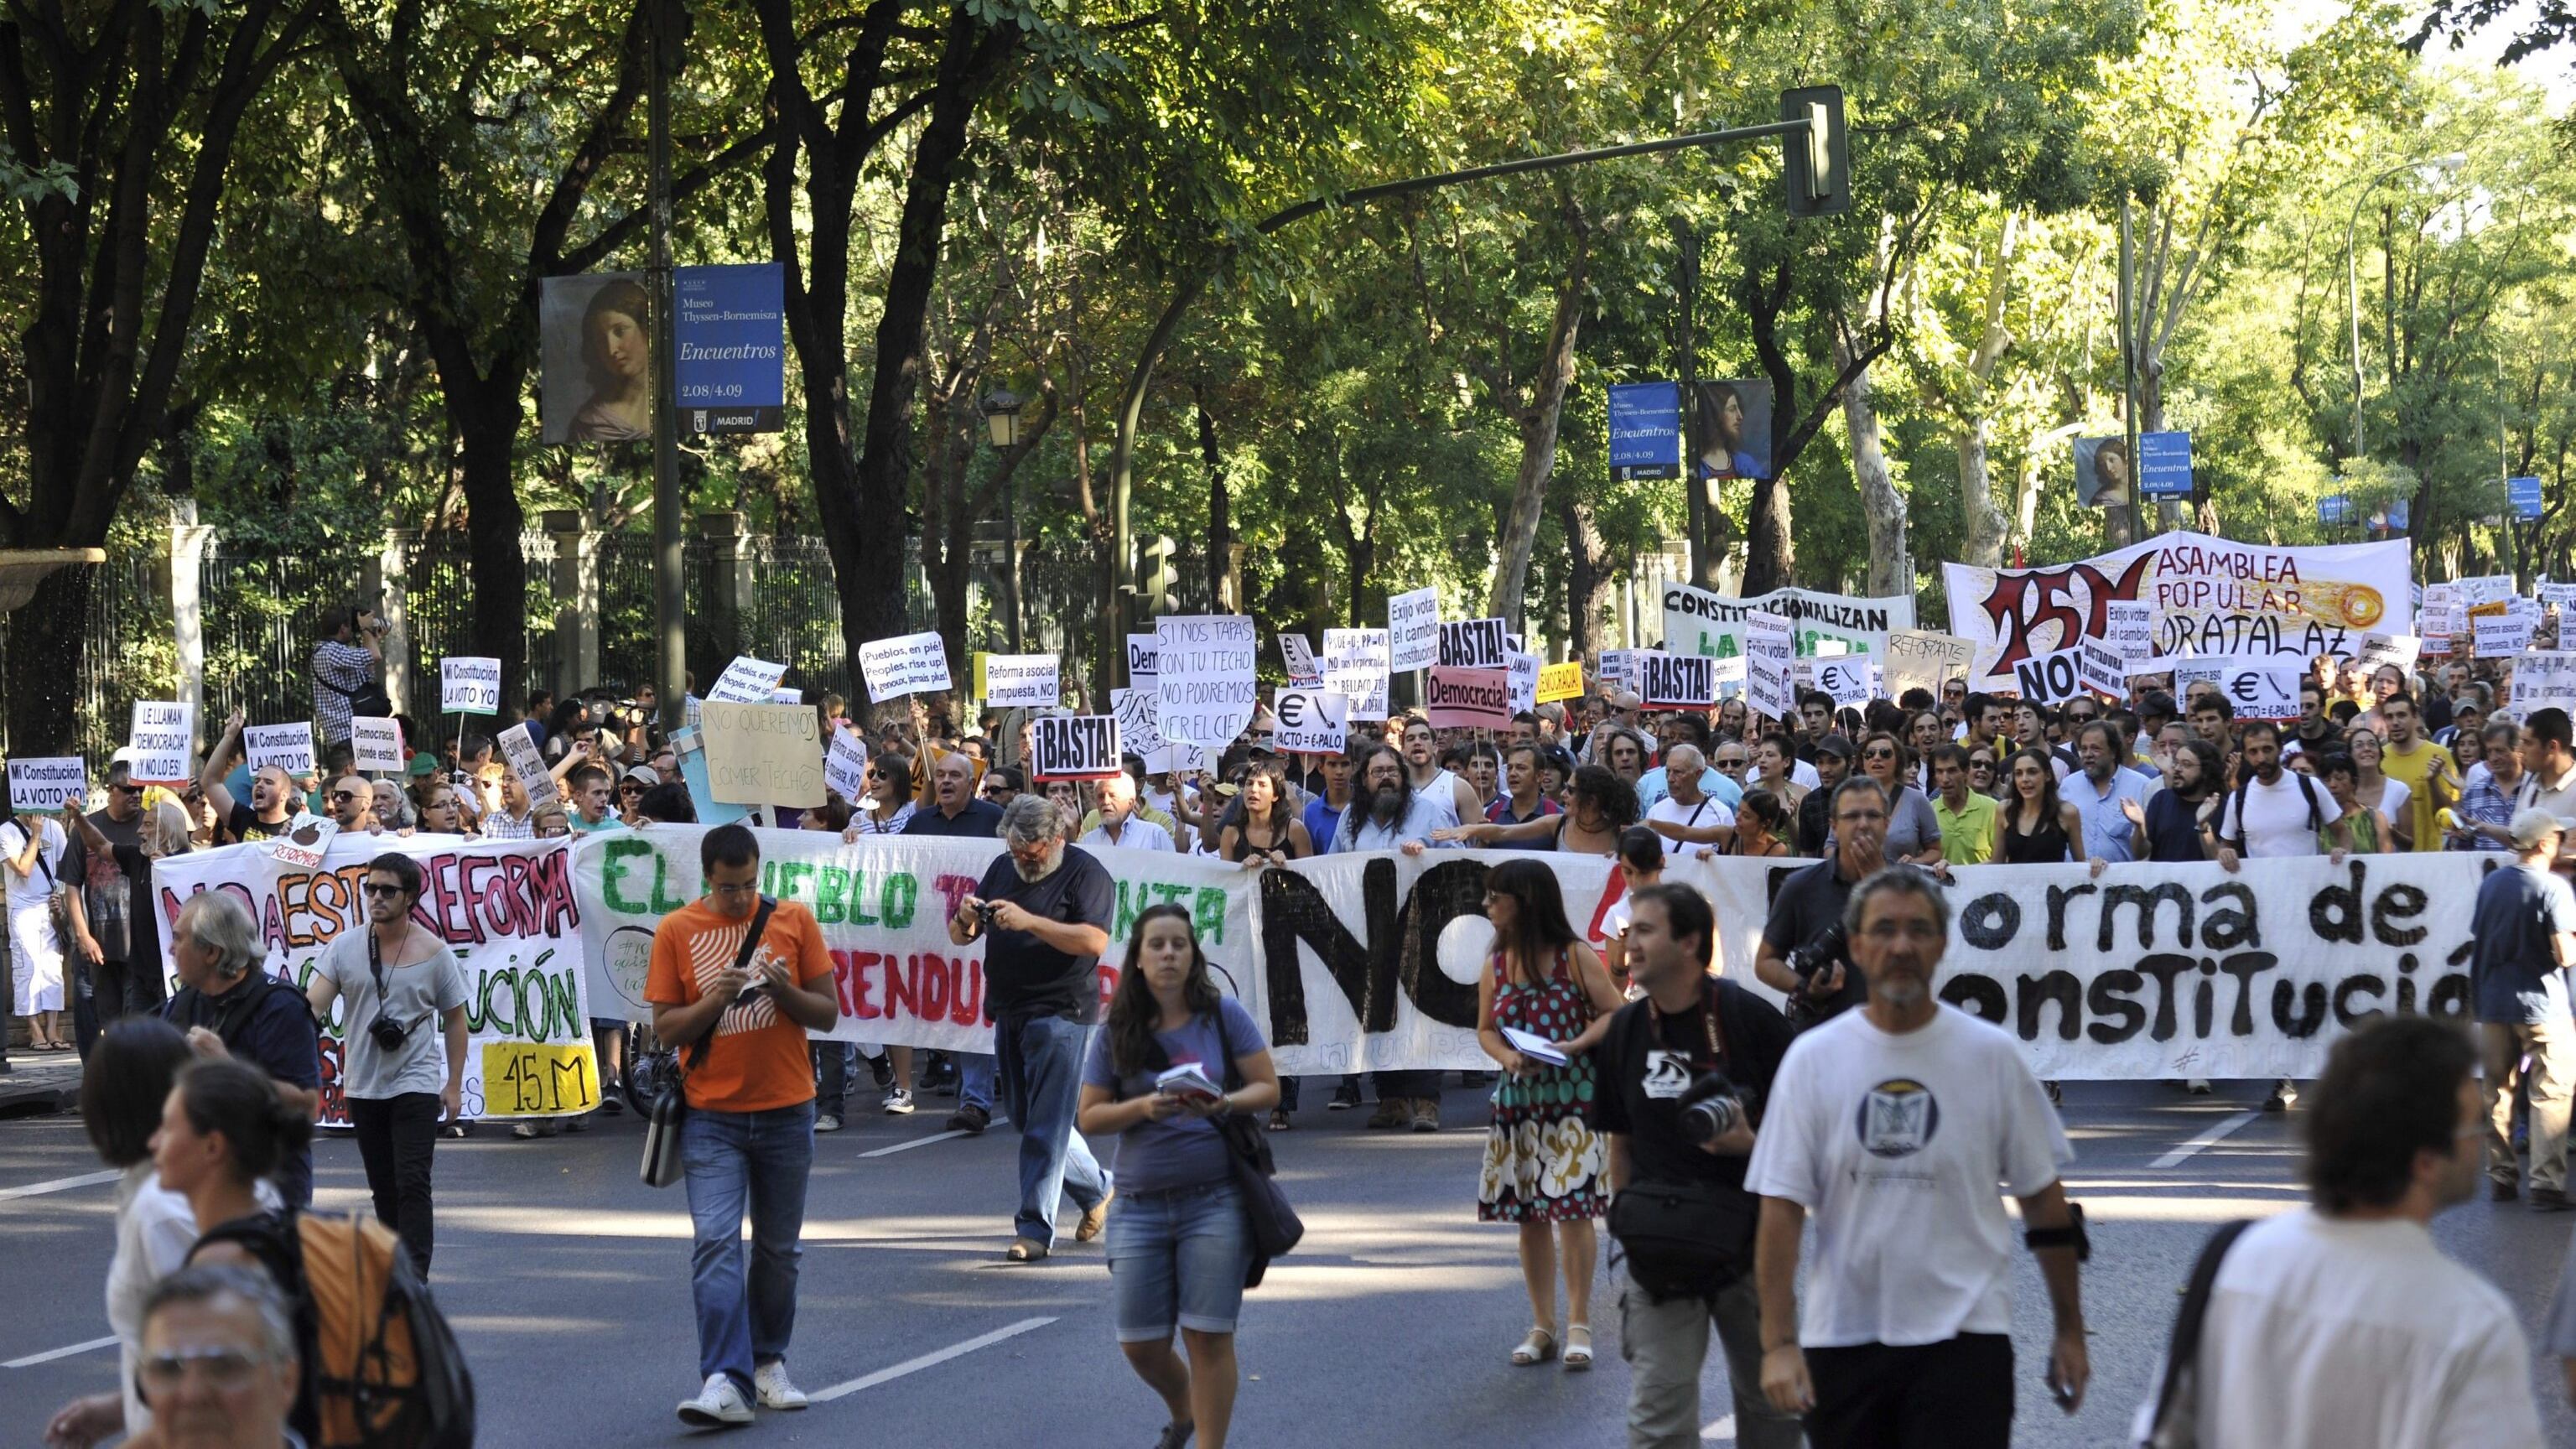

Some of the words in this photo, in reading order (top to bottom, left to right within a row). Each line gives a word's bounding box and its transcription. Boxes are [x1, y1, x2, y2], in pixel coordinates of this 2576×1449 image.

[683, 299, 714, 309] Museo
[682, 309, 777, 325] Thyssen-Bornemisza
[680, 342, 776, 361] Encuentros
[682, 384, 742, 399] 2.08/4.09
[716, 416, 754, 426] MADRID
[1613, 426, 1675, 439] Encuentros
[1613, 451, 1654, 461] 2.08/4.09
[2142, 465, 2189, 474] Encuentros
[2157, 546, 2300, 584] ASAMBLEA
[2158, 580, 2303, 614] POPULAR
[1392, 602, 1414, 623] Exijo
[1415, 598, 1436, 615] votar
[2109, 606, 2128, 624] Exijo
[2130, 610, 2150, 621] votar
[1159, 623, 1174, 647] SI
[1181, 623, 1208, 642] NOS
[1213, 621, 1252, 641] TAPAS
[1394, 629, 1405, 645] el
[1406, 621, 1438, 641] cambio
[1748, 617, 1768, 629] Reforma
[1769, 620, 1789, 633] asocial
[2110, 630, 2117, 640] el
[2119, 629, 2150, 641] cambio
[909, 646, 922, 656] en
[923, 642, 943, 659] pié!
[1768, 643, 1789, 659] votar
[2085, 644, 2123, 672] DICTADURA
[909, 658, 927, 669] rise
[929, 656, 945, 673] up!
[989, 664, 1023, 679] Reforma
[1026, 663, 1056, 677] asocial
[1159, 652, 1184, 675] CON
[1190, 652, 1206, 673] TU
[1213, 651, 1250, 672] TECHO
[1328, 657, 1338, 669] NO
[444, 663, 454, 680] Mi
[454, 663, 500, 683] Constitución,
[908, 673, 930, 688] jamais
[931, 672, 948, 687] plus!
[1643, 657, 1711, 705] ¡BASTA!
[444, 688, 454, 704] LA
[456, 687, 476, 704] VOTO
[480, 688, 498, 706] YO!
[989, 689, 995, 699] e
[996, 683, 1038, 702] impuesta,
[1040, 682, 1057, 697] NO!
[1160, 682, 1181, 704] NO
[1187, 681, 1254, 704] PODREMOS
[1430, 676, 1507, 709] Democracia!
[143, 708, 152, 724] LE
[153, 708, 182, 725] LLAMAN
[703, 709, 732, 731] NO
[739, 709, 818, 740] QUEREMOS
[355, 725, 394, 742] Democracia
[1159, 714, 1191, 740] VER
[1194, 714, 1211, 740] EL
[135, 735, 188, 751] "DEMOCRACIA"
[247, 732, 258, 749] Mi
[1036, 718, 1116, 776] ¡BASTA!
[137, 758, 145, 780] ¡Y
[146, 759, 158, 776] NO
[160, 760, 168, 776] LO
[169, 758, 181, 776] ES!
[250, 755, 263, 771] LA
[12, 765, 22, 781] Mi
[23, 764, 84, 783] Constitución,
[13, 789, 28, 804] LA
[30, 787, 63, 804] VOTO
[65, 787, 86, 804] YO!
[602, 835, 686, 916] EL
[278, 862, 371, 948] EST
[410, 847, 580, 945] REFORMA
[2309, 860, 2428, 948] de
[1260, 858, 1494, 1047] NO
